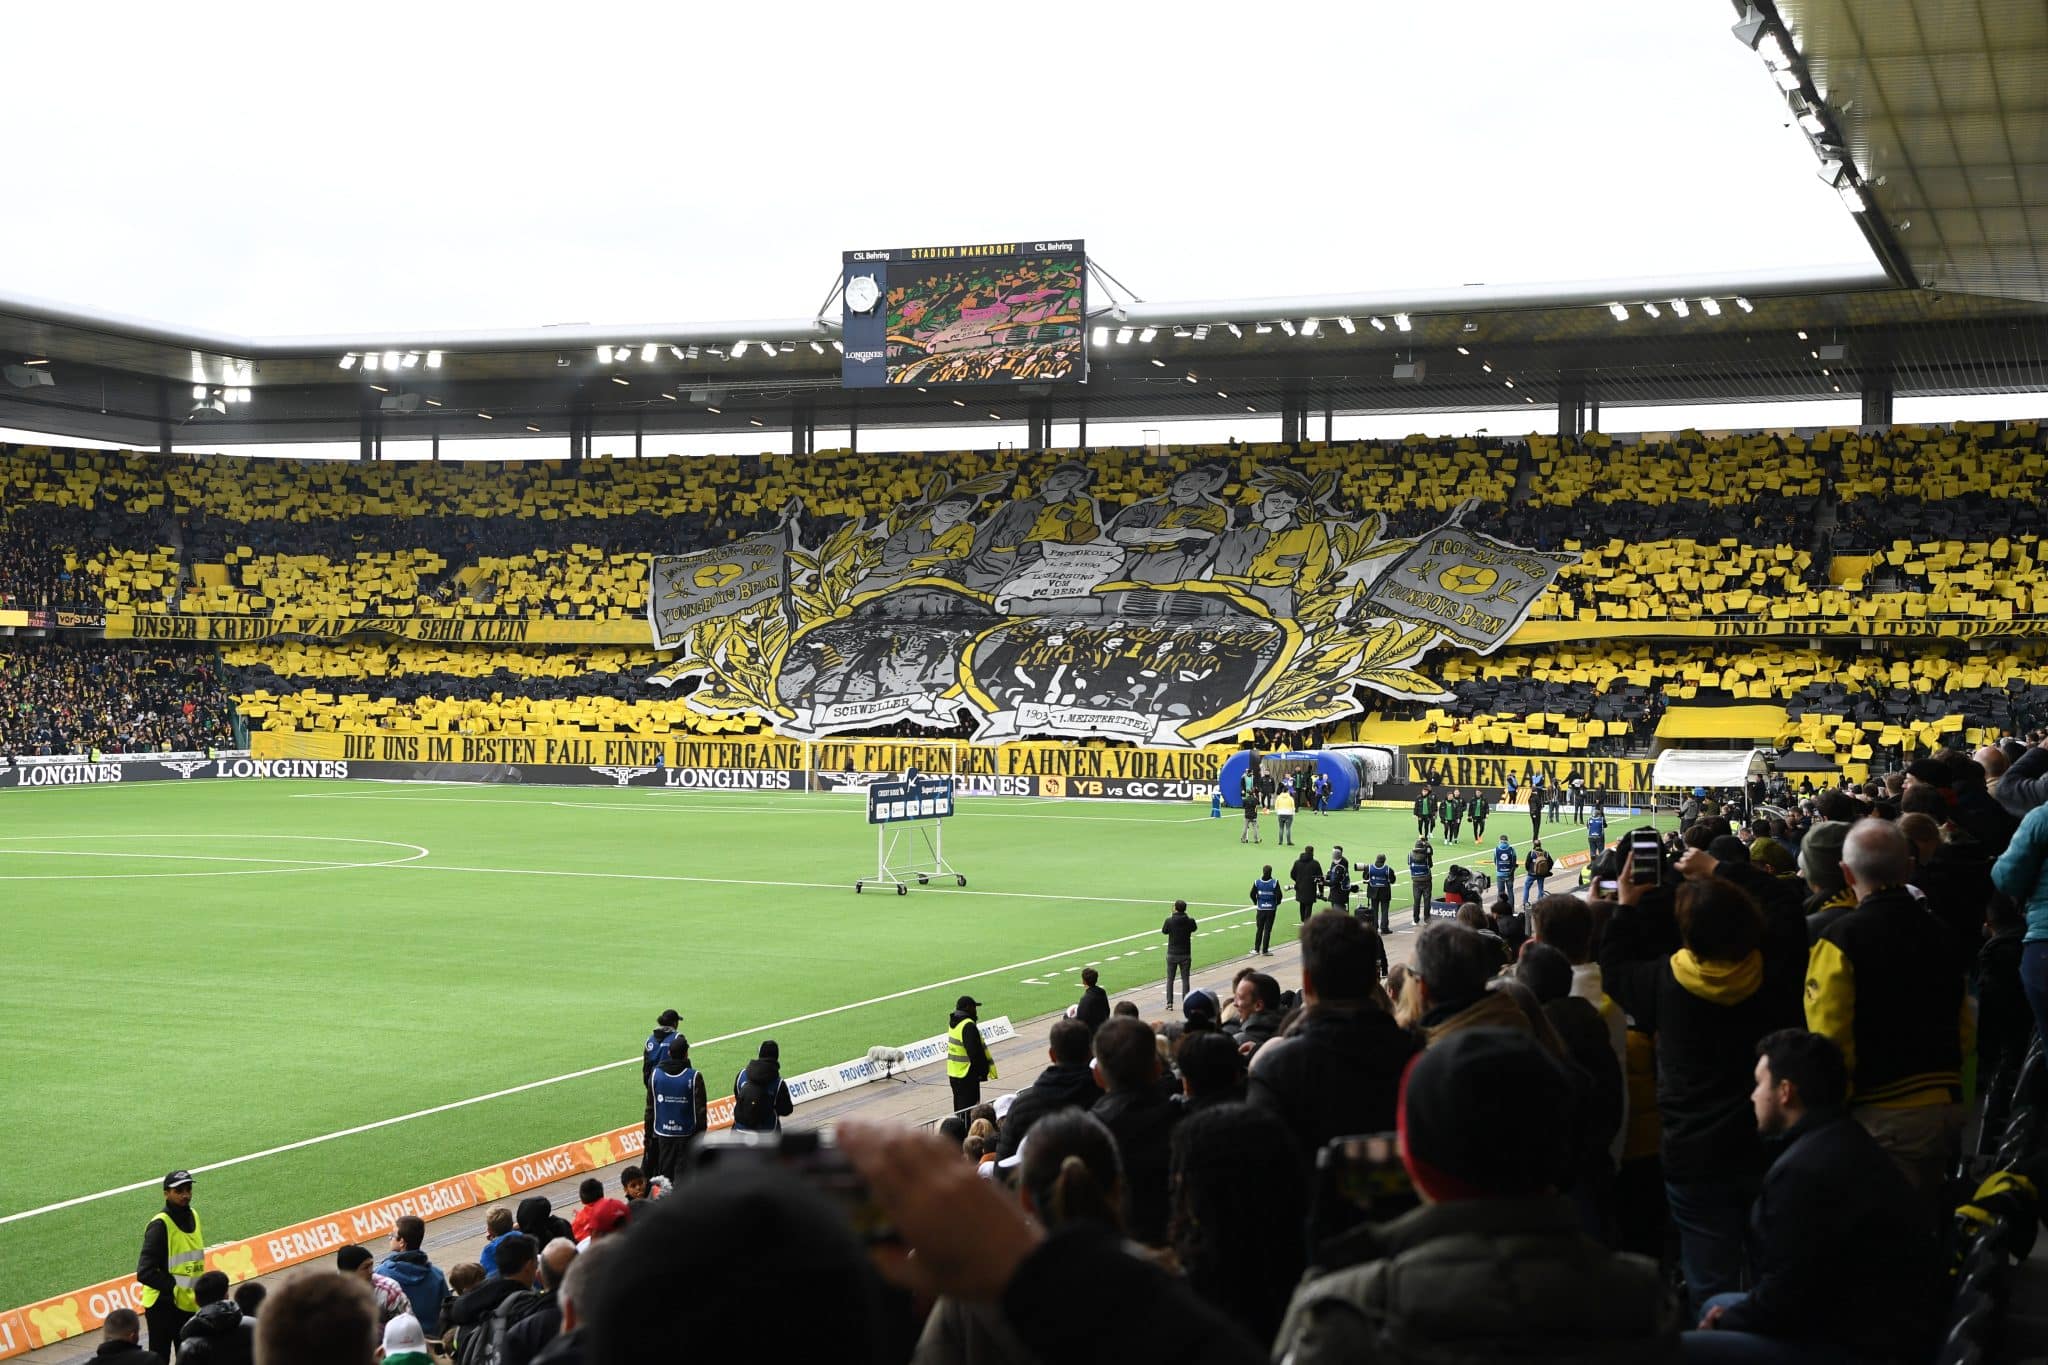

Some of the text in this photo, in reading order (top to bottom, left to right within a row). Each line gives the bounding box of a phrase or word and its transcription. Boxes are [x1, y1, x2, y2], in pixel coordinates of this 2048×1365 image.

[866, 252, 890, 261] Behring
[911, 244, 1016, 259] STADION WANKDORF
[1048, 242, 1073, 252] Behring
[845, 351, 884, 360] LONGINES
[132, 615, 198, 639] UNSER
[207, 617, 290, 641] KREDIT
[298, 618, 346, 637] WAR
[417, 619, 464, 641] SEHR
[471, 620, 530, 642] KLEIN
[1457, 603, 1507, 636] BERN
[1714, 621, 1767, 636] UND
[1783, 621, 1831, 636] DIE
[833, 697, 911, 718] SCHWELLER
[1025, 708, 1049, 722] 1903
[344, 734, 375, 760] DIE
[383, 735, 420, 762] UNS
[427, 736, 453, 763] IM
[462, 737, 537, 764] BESTEN
[546, 739, 597, 766] FALL
[606, 739, 667, 767] EINEN
[675, 740, 801, 770] UNTERGANG
[811, 743, 855, 770] MIT
[18, 763, 122, 786] LONGINES
[216, 758, 349, 779] LONGINES
[664, 767, 791, 790] LONGINES
[1409, 756, 1506, 787] WAREN
[1073, 780, 1103, 796] YB
[1107, 786, 1123, 796] vs
[1126, 782, 1159, 797] GC
[1439, 907, 1457, 918] Sport
[809, 1077, 830, 1092] Glas.
[511, 1151, 576, 1186] ORANGE
[267, 1222, 346, 1264] BERNER
